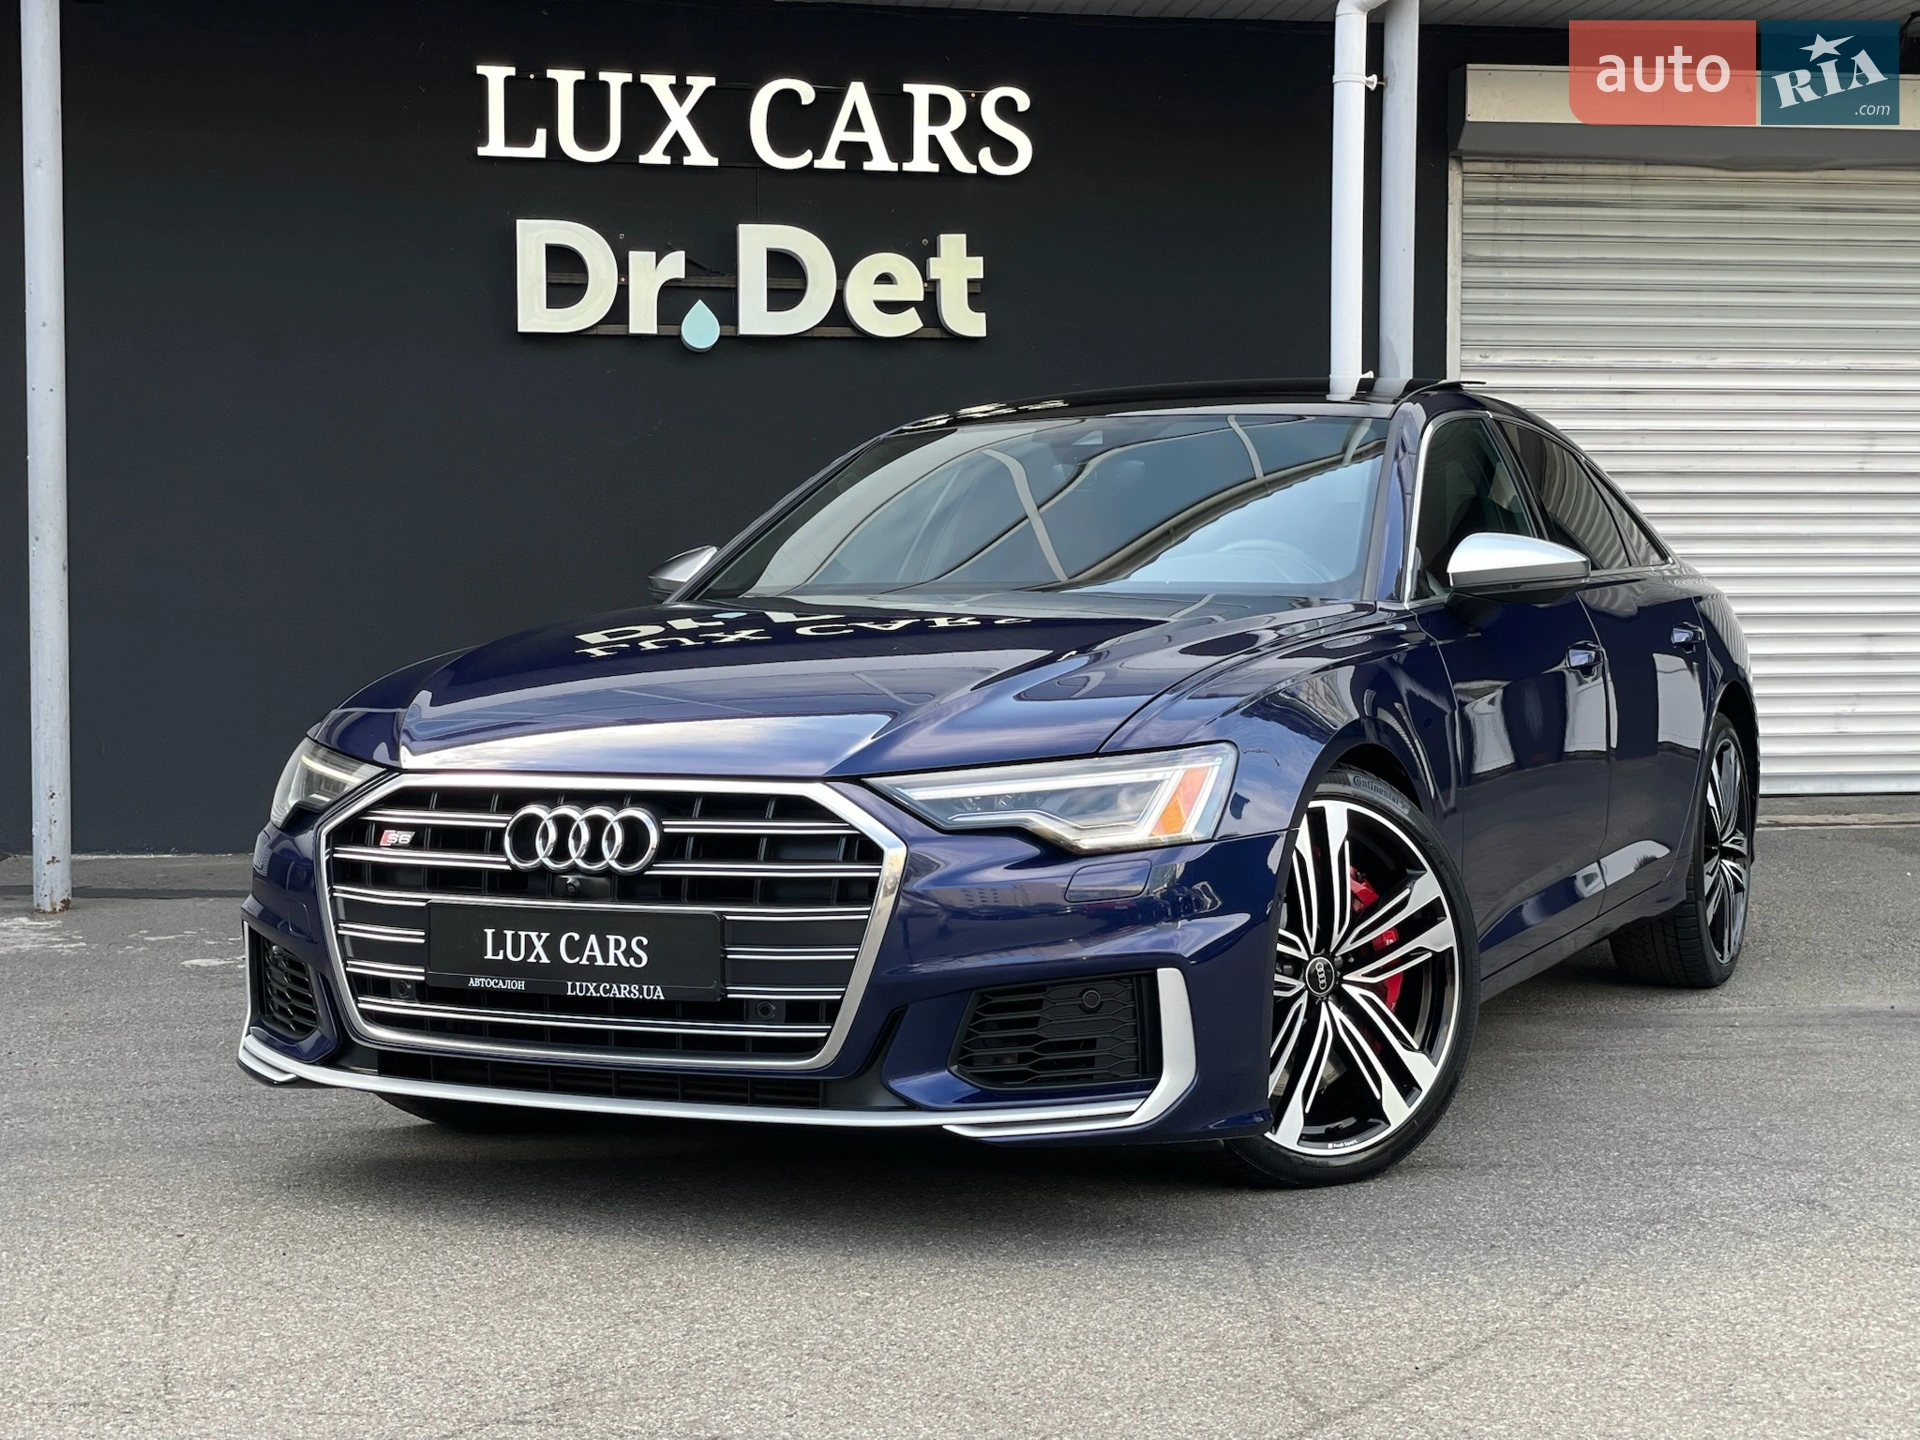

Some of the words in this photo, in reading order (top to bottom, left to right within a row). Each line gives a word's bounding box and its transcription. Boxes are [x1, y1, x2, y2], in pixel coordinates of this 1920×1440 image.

[476, 64, 719, 167] LUX
[749, 78, 1033, 176] CARS
[385, 832, 412, 845] S6
[483, 928, 551, 964] LUX
[559, 932, 648, 968] CARS
[468, 977, 526, 990] АВТОСАЛОН
[566, 981, 665, 1000] LUX.CARS.UA
